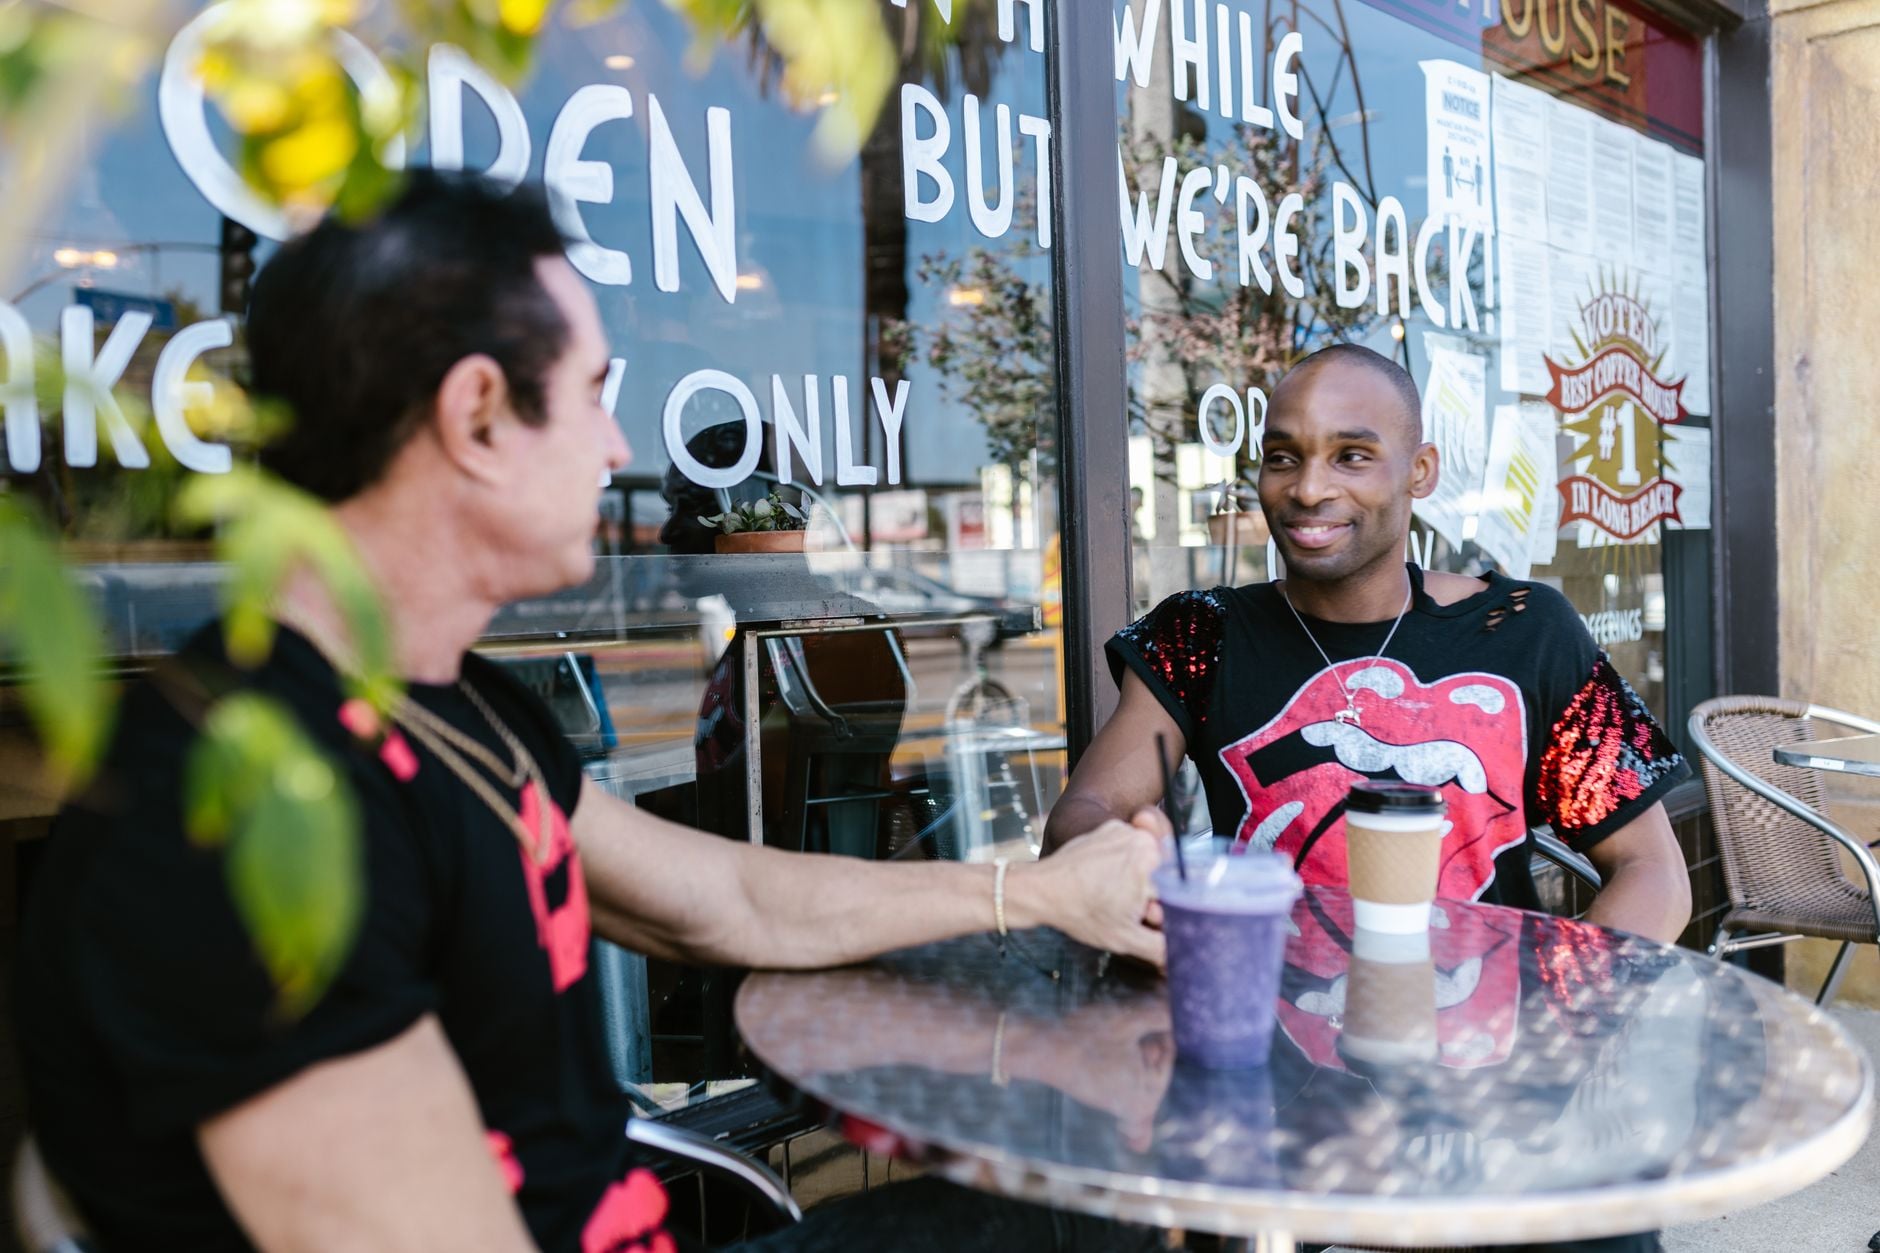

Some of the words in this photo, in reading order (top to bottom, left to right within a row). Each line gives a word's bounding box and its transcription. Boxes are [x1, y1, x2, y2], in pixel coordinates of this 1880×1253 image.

[1113, 2, 1304, 141] WHILE
[1443, 93, 1481, 121] NOTICE
[901, 83, 1051, 249] BUT
[1117, 142, 1304, 298] WE'RE
[1332, 181, 1496, 334] BACK!
[1583, 296, 1658, 361] VOTED
[663, 368, 911, 489] ONLY
[1560, 367, 1594, 408] BEST
[1594, 351, 1641, 396] COFFEE
[1641, 370, 1679, 420] HOUSE
[1598, 399, 1641, 486] #1
[1571, 481, 1590, 514] IN
[1591, 485, 1630, 536] LONG
[1630, 483, 1675, 535] BEACH
